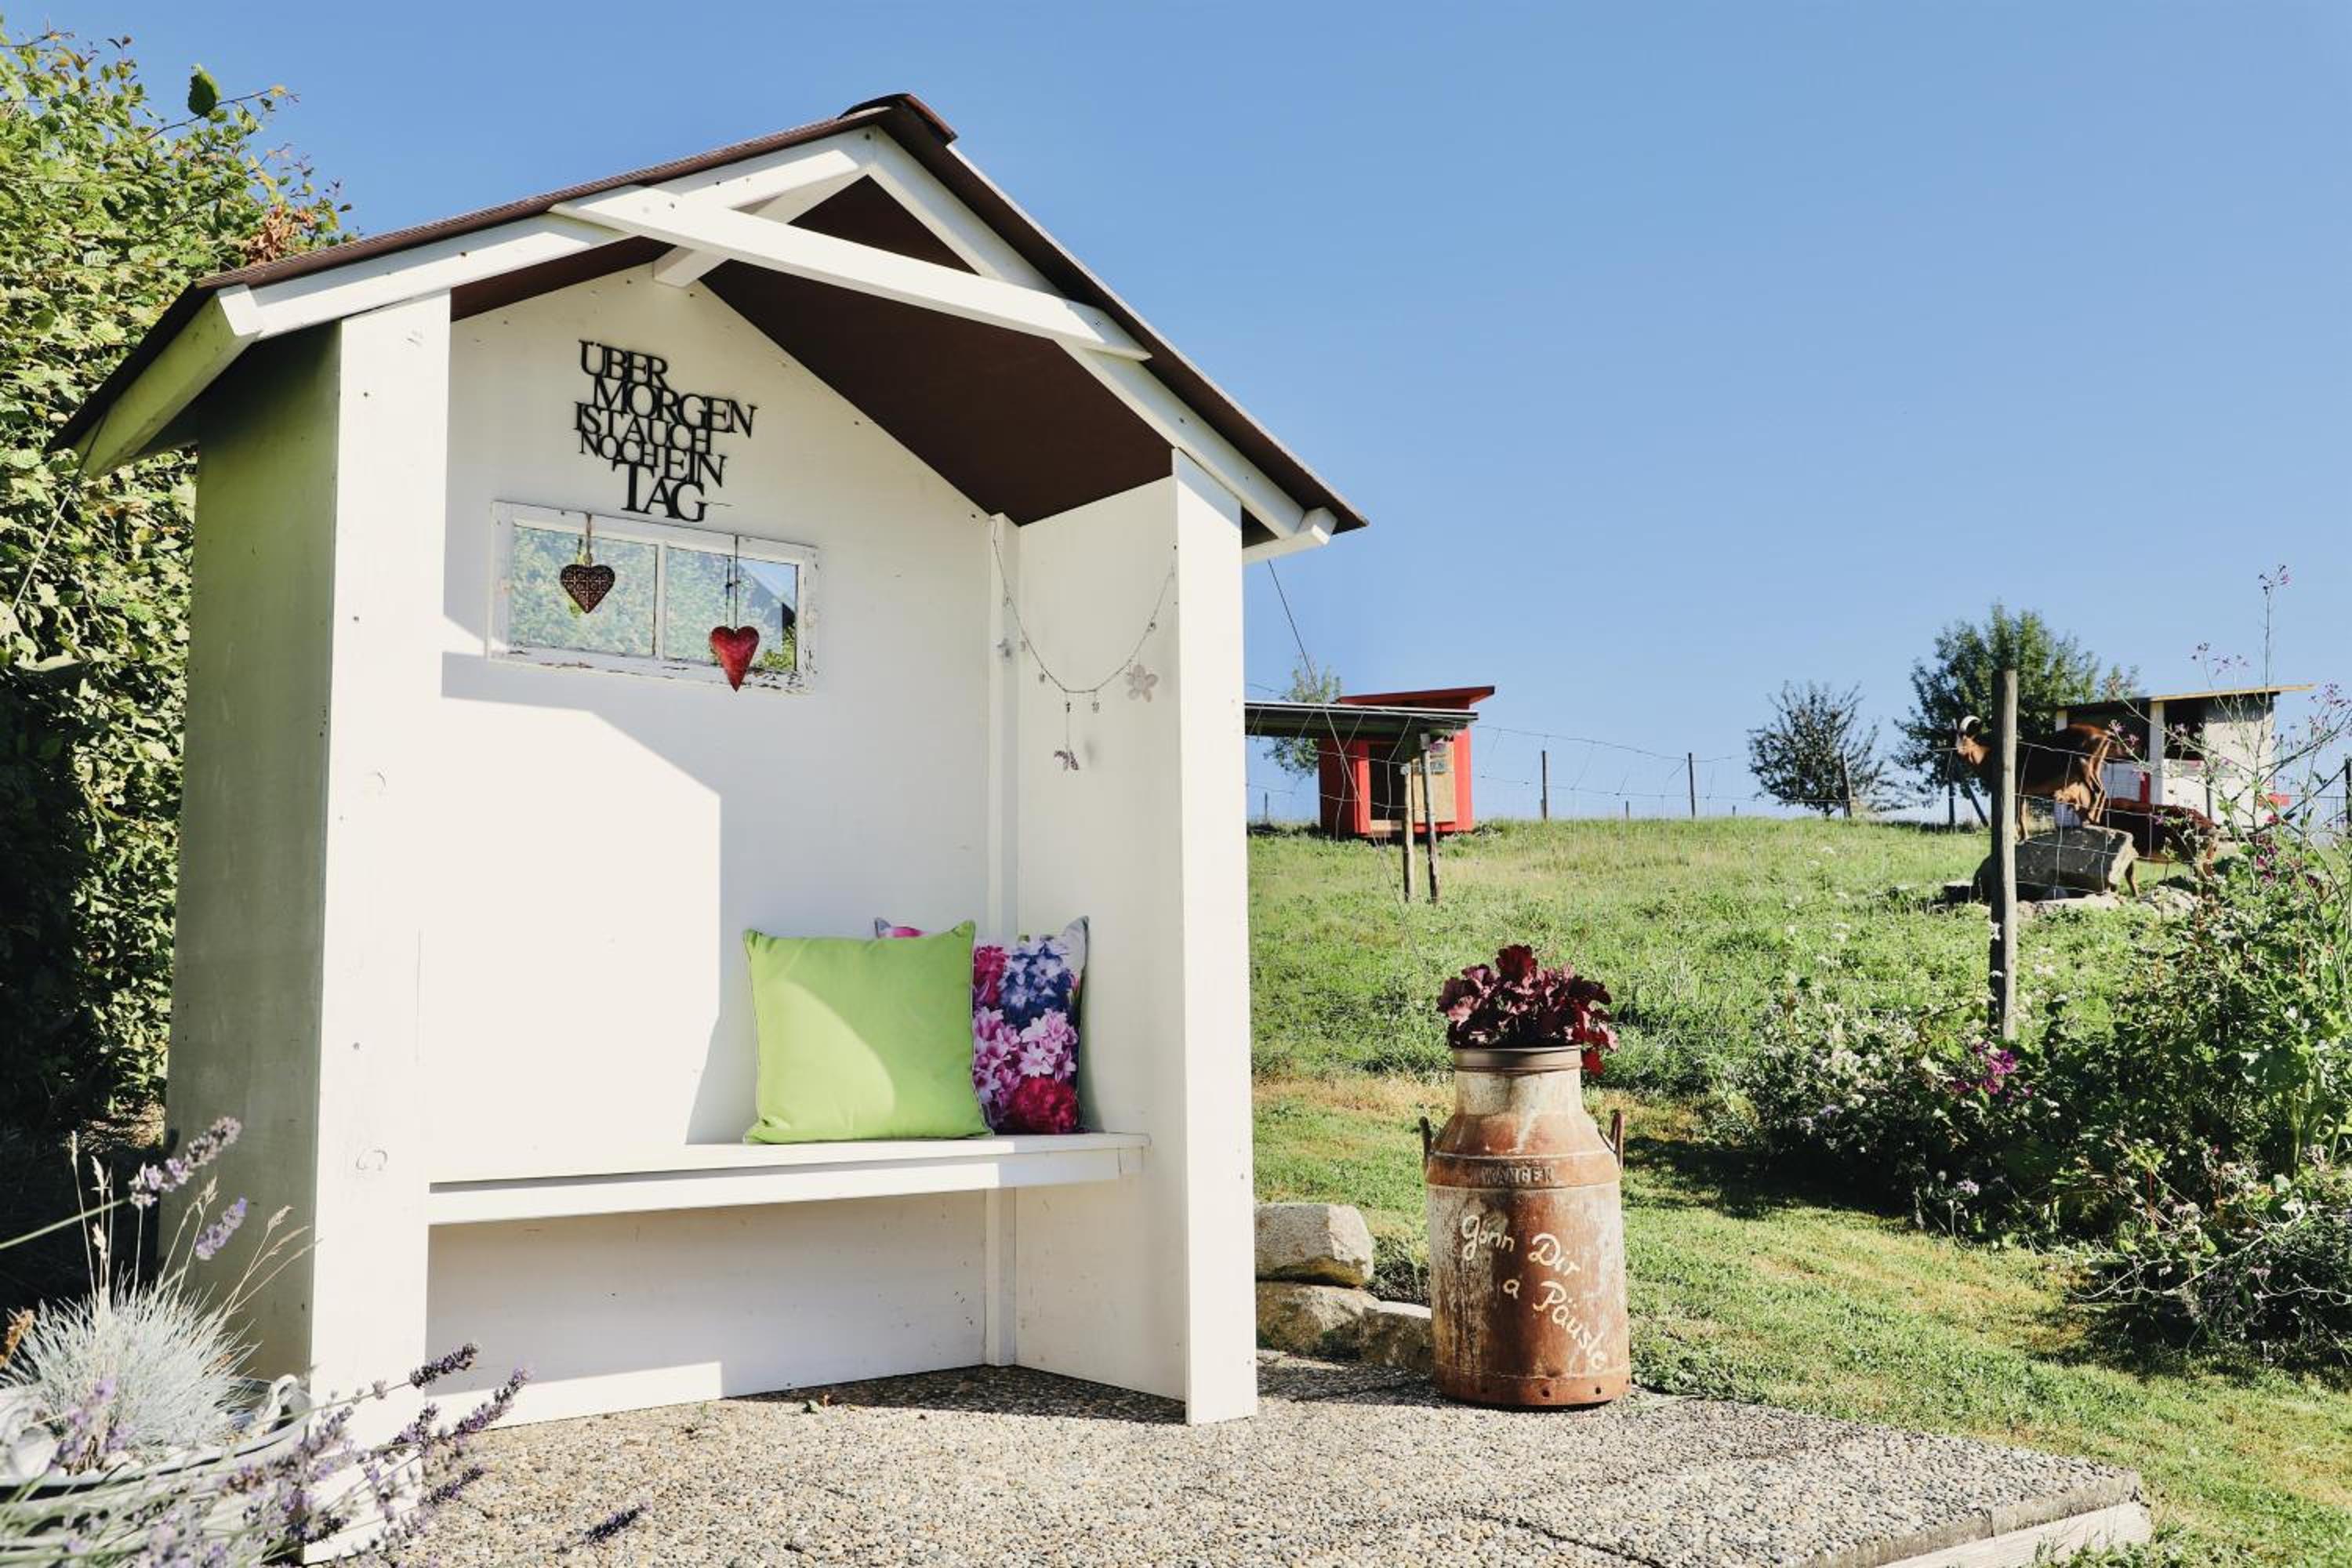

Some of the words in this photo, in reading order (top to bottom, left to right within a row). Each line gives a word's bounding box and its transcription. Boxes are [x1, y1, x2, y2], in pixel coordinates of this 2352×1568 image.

[579, 339, 668, 390] ÜBER
[574, 401, 625, 437] IST
[623, 415, 712, 455] AUCH
[593, 375, 758, 438] MORGEN
[579, 428, 660, 468] NOCH
[666, 446, 728, 488] EIN
[612, 458, 709, 522] TAG
[1528, 1232, 1581, 1276] Dir
